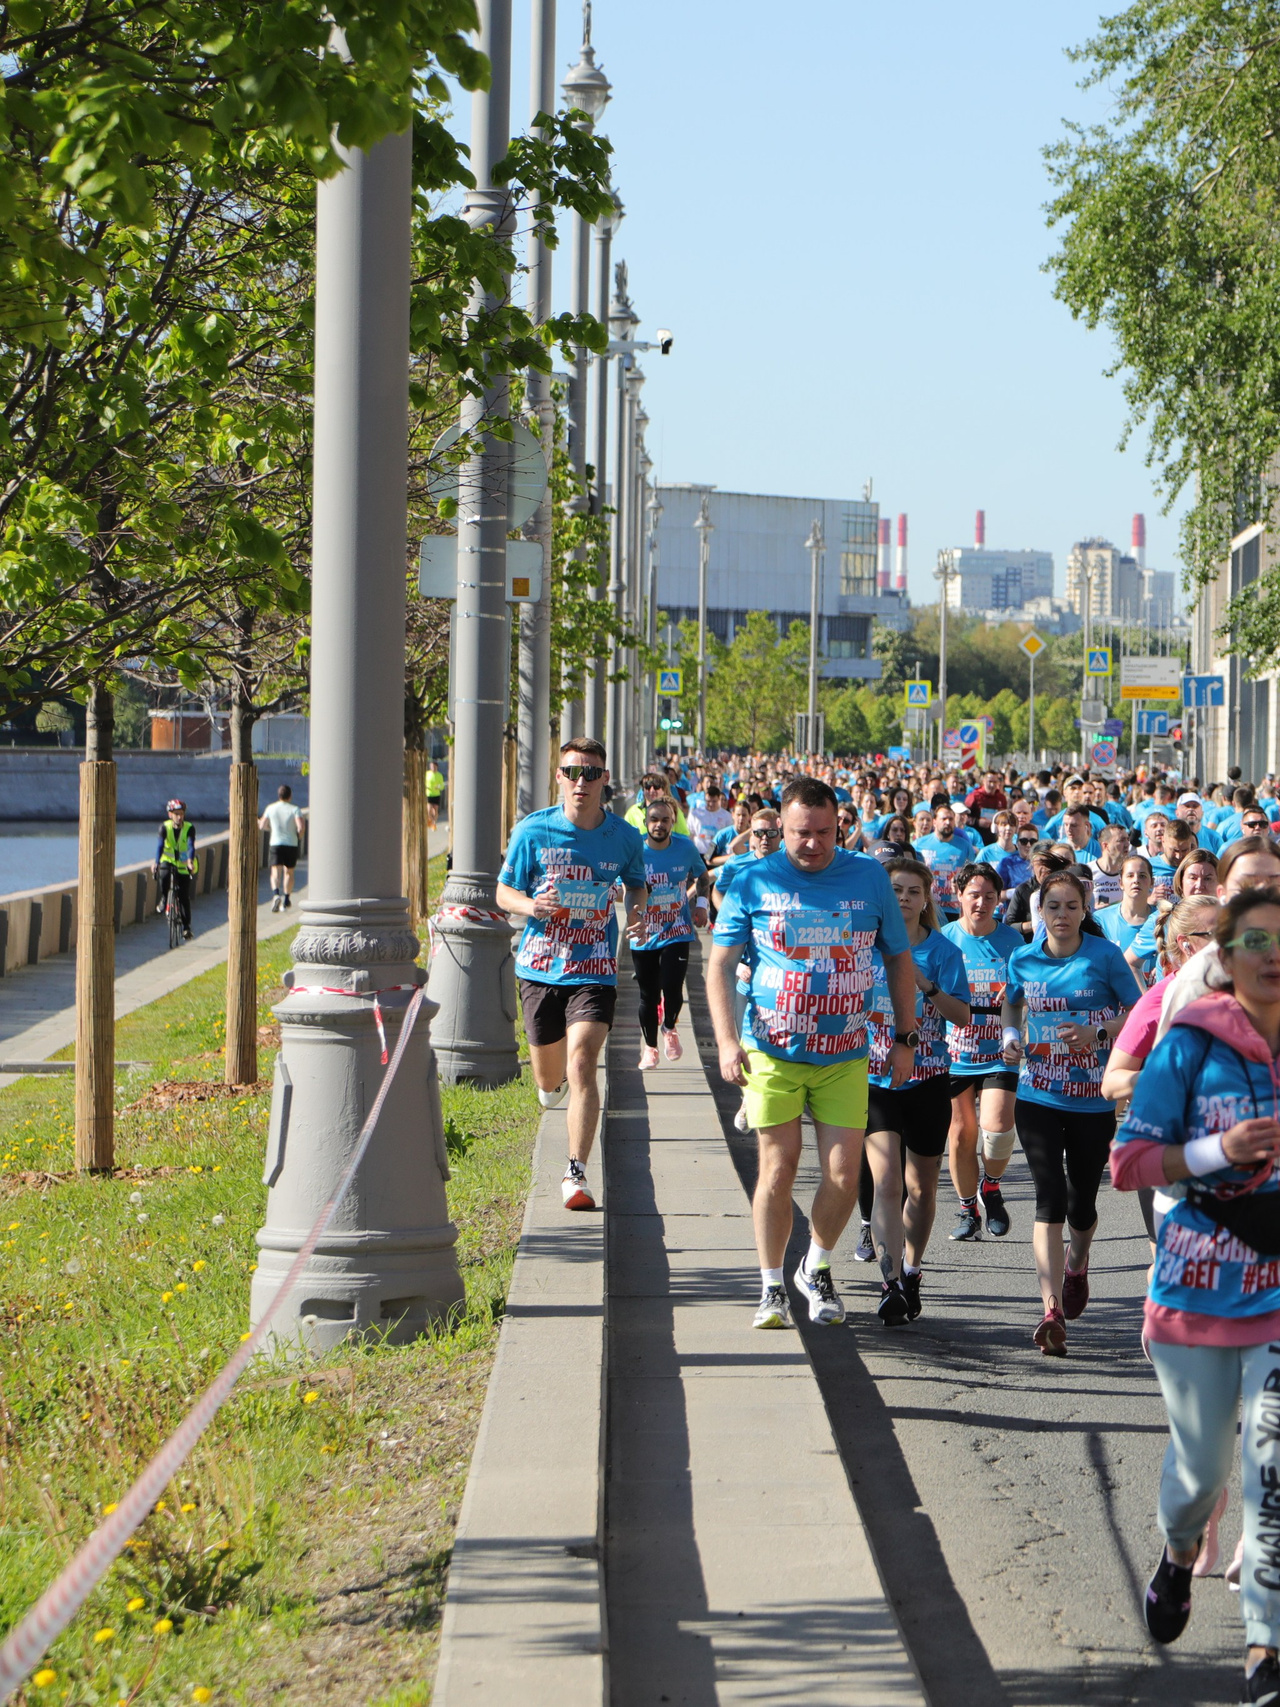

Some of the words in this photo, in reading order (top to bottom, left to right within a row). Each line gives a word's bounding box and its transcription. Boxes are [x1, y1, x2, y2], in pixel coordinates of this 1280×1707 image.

[540, 847, 573, 865] 2024
[546, 864, 593, 881] #МЕЧТА
[644, 863, 654, 875] 24
[563, 891, 597, 908] 21732
[761, 892, 802, 911] 2024
[569, 907, 587, 920] 5KM
[544, 923, 606, 945] #ГОРДОСТЬ
[798, 927, 841, 944] 22624
[809, 946, 831, 960] 5KM
[761, 966, 812, 993] #ЗАБЕГ
[967, 969, 997, 981] 21572
[973, 982, 991, 992] 5KM
[775, 990, 864, 1015] #ГОРДОСТЬ
[1028, 997, 1068, 1012] #МЕЧТА
[1050, 1042, 1070, 1056] 5KM
[1062, 1082, 1101, 1098] #ЕДИН
[1128, 1118, 1164, 1139] ПСБ
